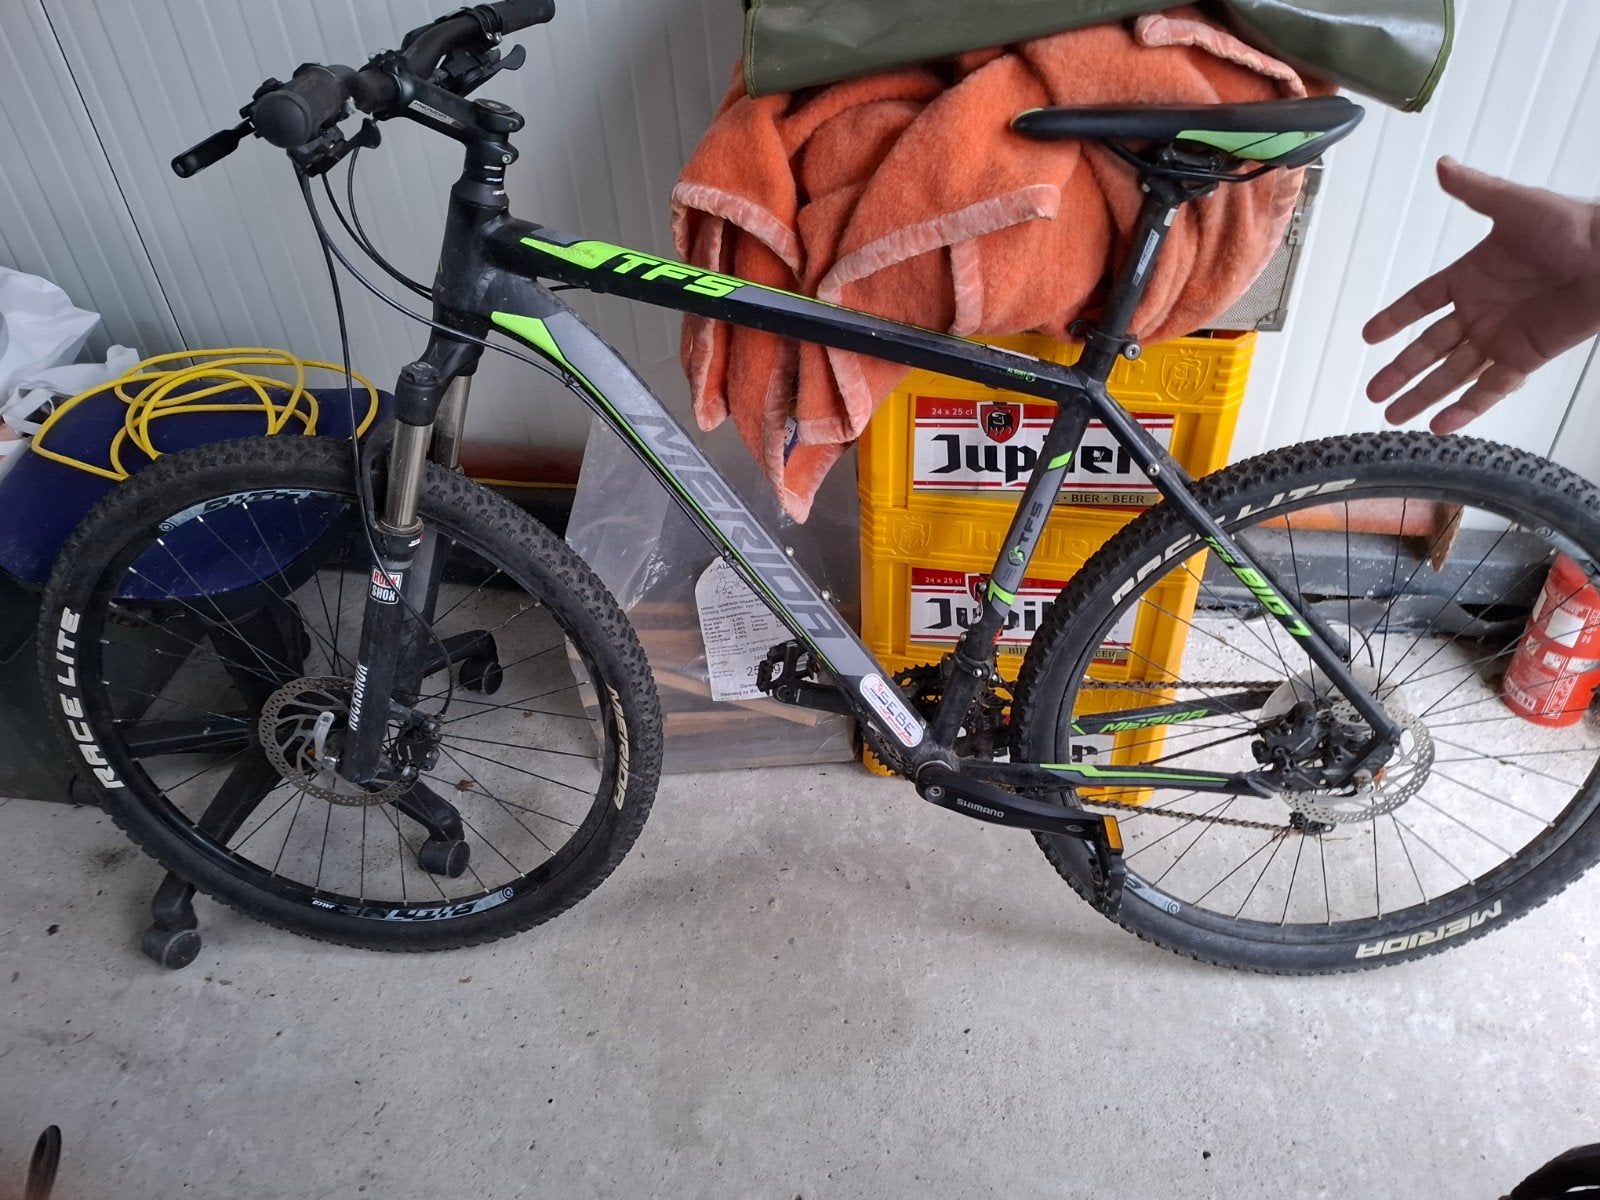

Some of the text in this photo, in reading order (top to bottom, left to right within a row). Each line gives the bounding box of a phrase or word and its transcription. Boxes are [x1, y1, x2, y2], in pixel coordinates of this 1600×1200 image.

[612, 252, 749, 298] TFS
[931, 407, 943, 416] 24
[952, 408, 965, 416] 25
[1071, 493, 1100, 504] BIER
[1112, 494, 1145, 505] BEER
[1237, 477, 1357, 521] LITE
[625, 413, 847, 638] MERIDA
[1017, 500, 1044, 544] TFS
[371, 585, 396, 602] SHOX
[925, 576, 936, 584] 24
[943, 577, 954, 585] 25
[1231, 567, 1294, 616] BIG
[1094, 650, 1117, 659] EER
[56, 606, 125, 789] RACE LITE
[880, 691, 915, 737] SEBE
[1099, 708, 1210, 734] MERIDA
[605, 683, 630, 810] MERIDA
[956, 797, 1005, 819] SHIMANO
[1355, 899, 1502, 959] MERIDA
